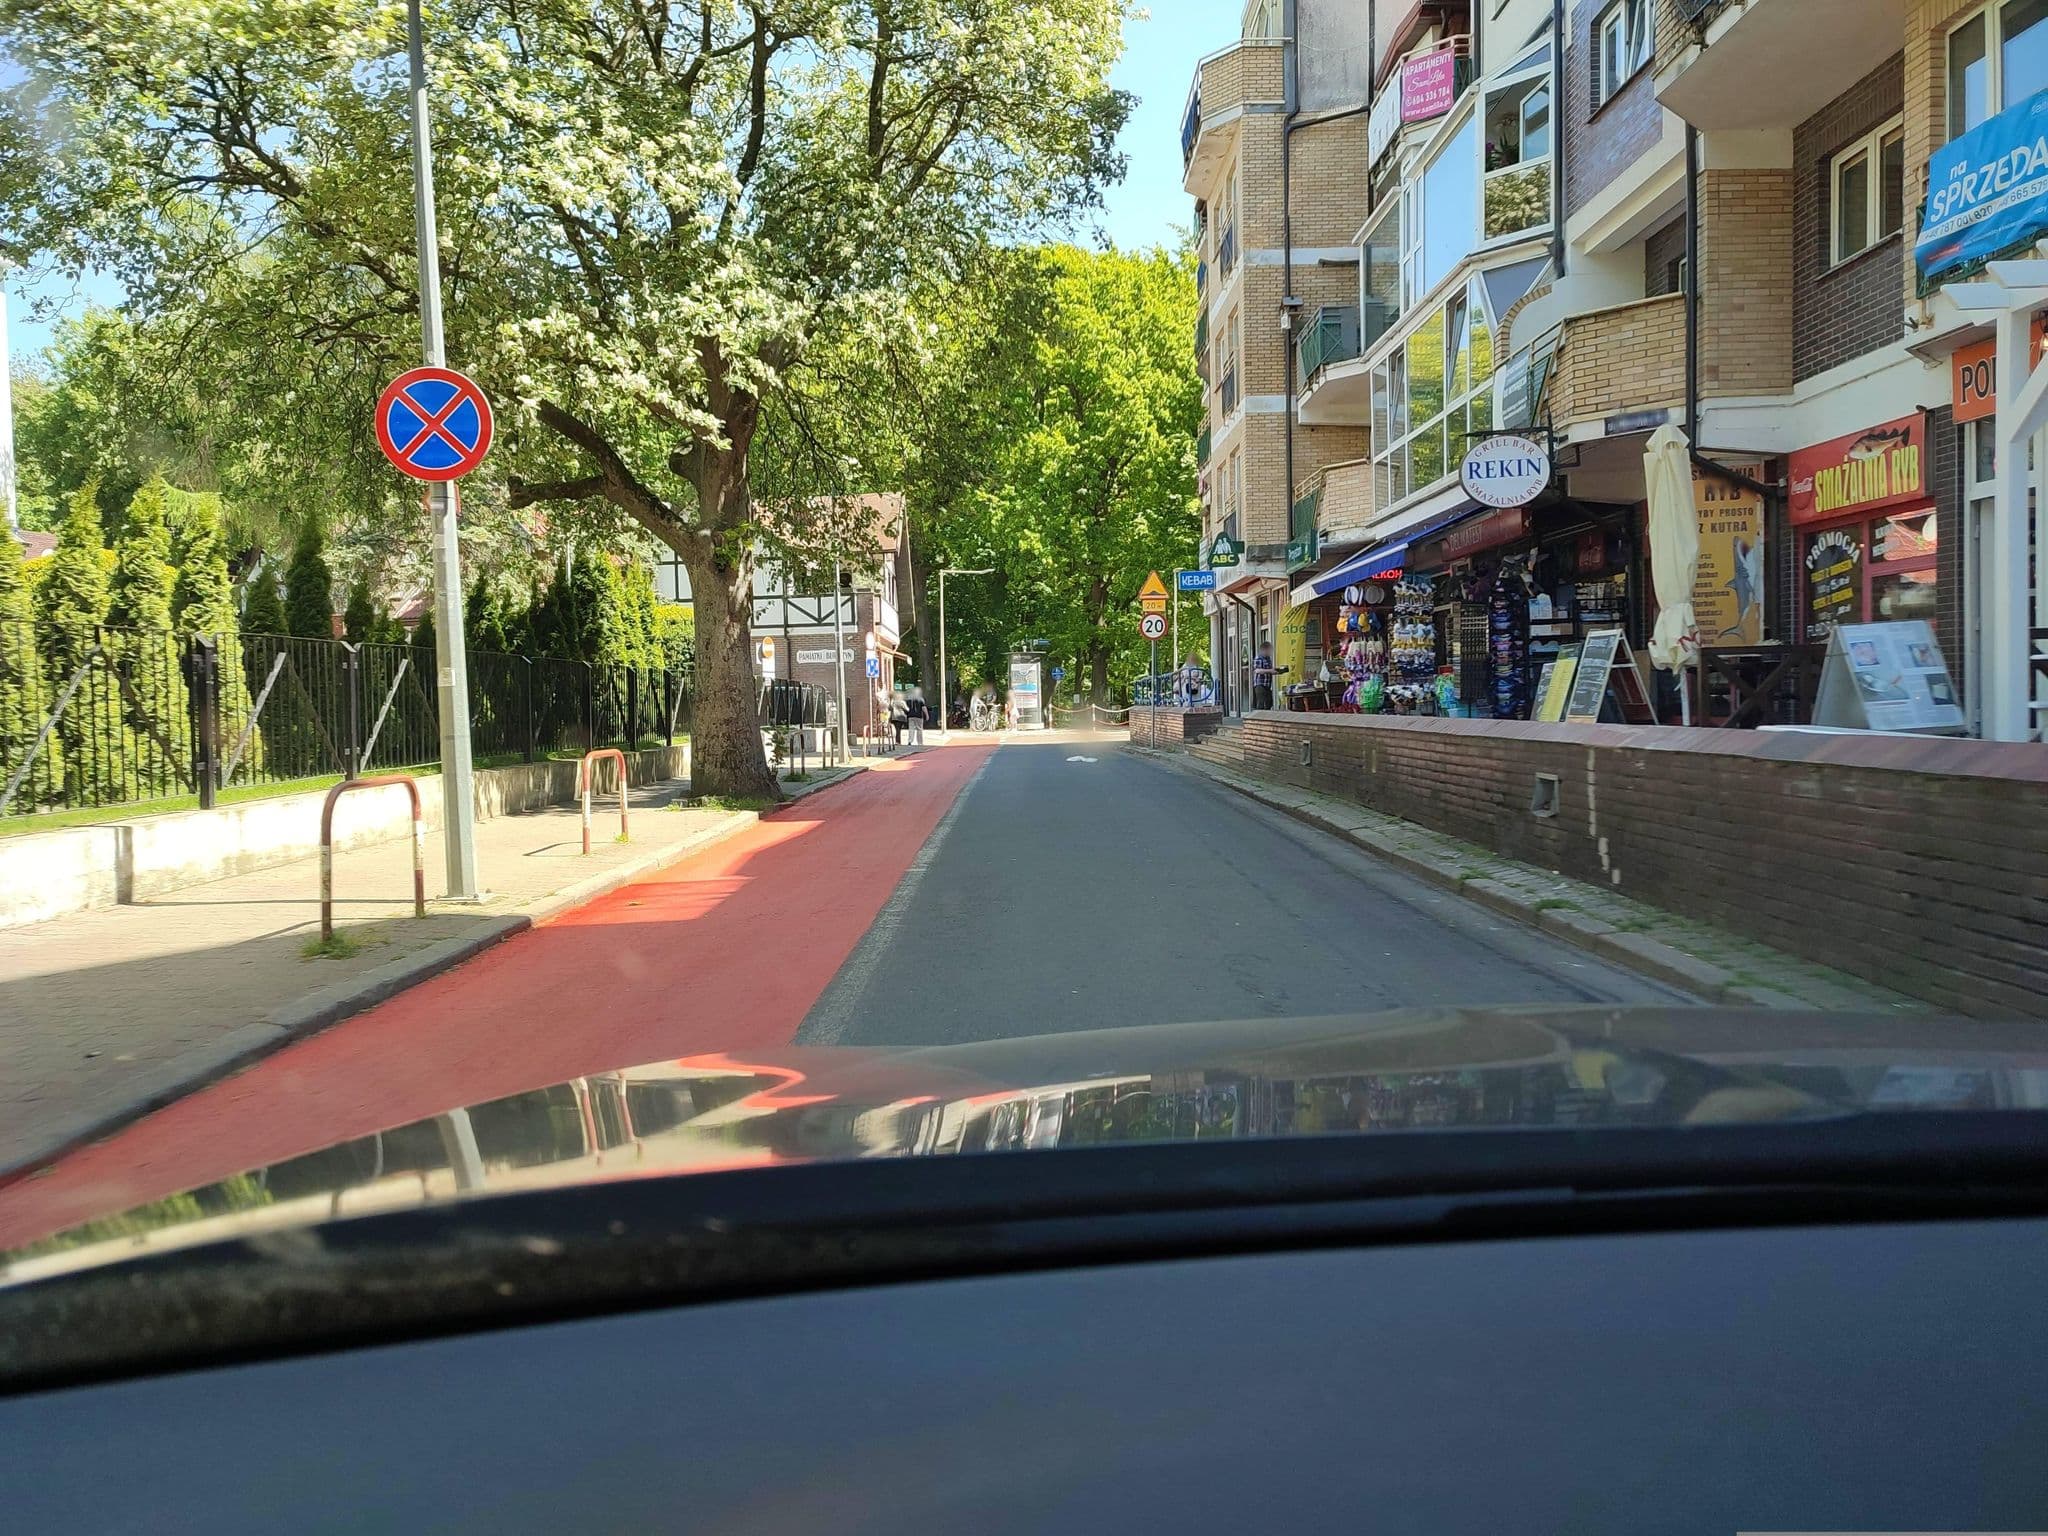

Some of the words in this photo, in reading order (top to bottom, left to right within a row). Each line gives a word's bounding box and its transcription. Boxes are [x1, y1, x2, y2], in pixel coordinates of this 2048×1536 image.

[1405, 52, 1452, 77] APARTAMENTY
[1950, 160, 1968, 181] na
[1974, 204, 1994, 221] 820
[2009, 187, 2029, 203] 665
[1474, 439, 1509, 458] GRILL
[1512, 439, 1536, 455] BAR
[1468, 457, 1542, 480] REKIN
[1815, 453, 1888, 513] SMAŻALNIA
[1891, 444, 1920, 496] RYB
[1526, 479, 1544, 497] RYB
[1697, 508, 1714, 519] YBY
[1719, 507, 1754, 518] PROSTO
[1710, 520, 1748, 534] KUTRA
[1211, 554, 1235, 564] ABC
[1805, 531, 1860, 570] PROMOCJA
[1181, 575, 1214, 586] KEBAB
[1146, 602, 1156, 610] 20
[1145, 619, 1164, 633] 20
[1281, 623, 1307, 635] abc
